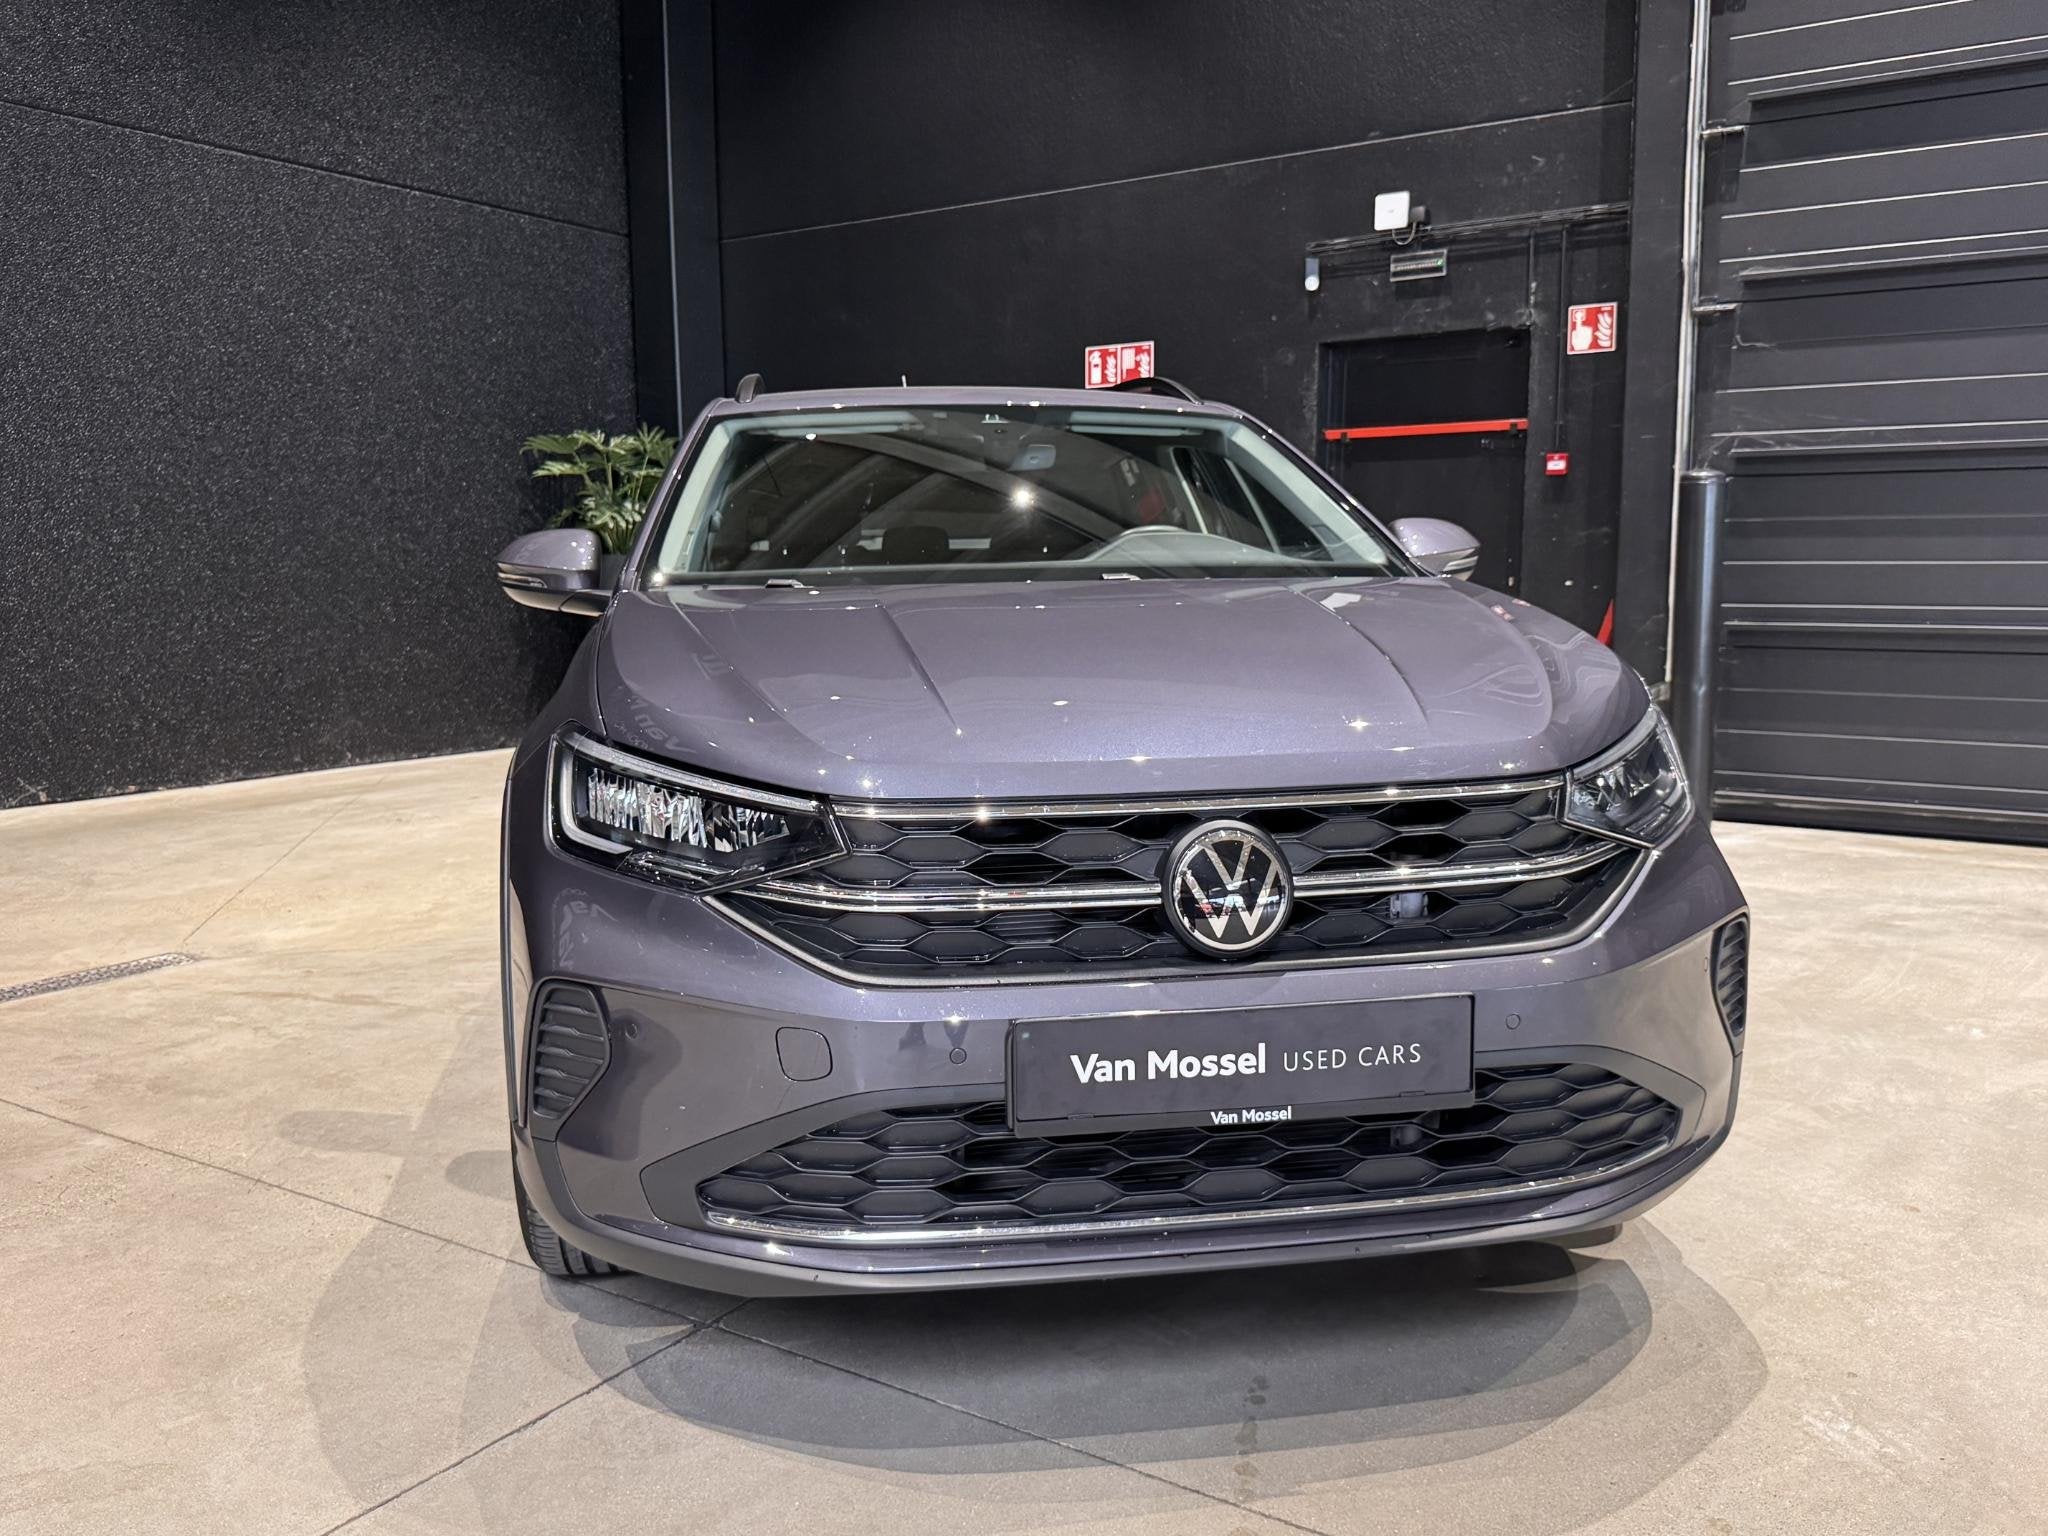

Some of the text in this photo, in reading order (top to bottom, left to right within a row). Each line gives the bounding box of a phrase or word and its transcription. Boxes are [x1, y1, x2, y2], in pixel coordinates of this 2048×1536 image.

[1070, 1042, 1421, 1084] Van Mossel USED CARS
[1210, 1105, 1292, 1125] Van Mossel
